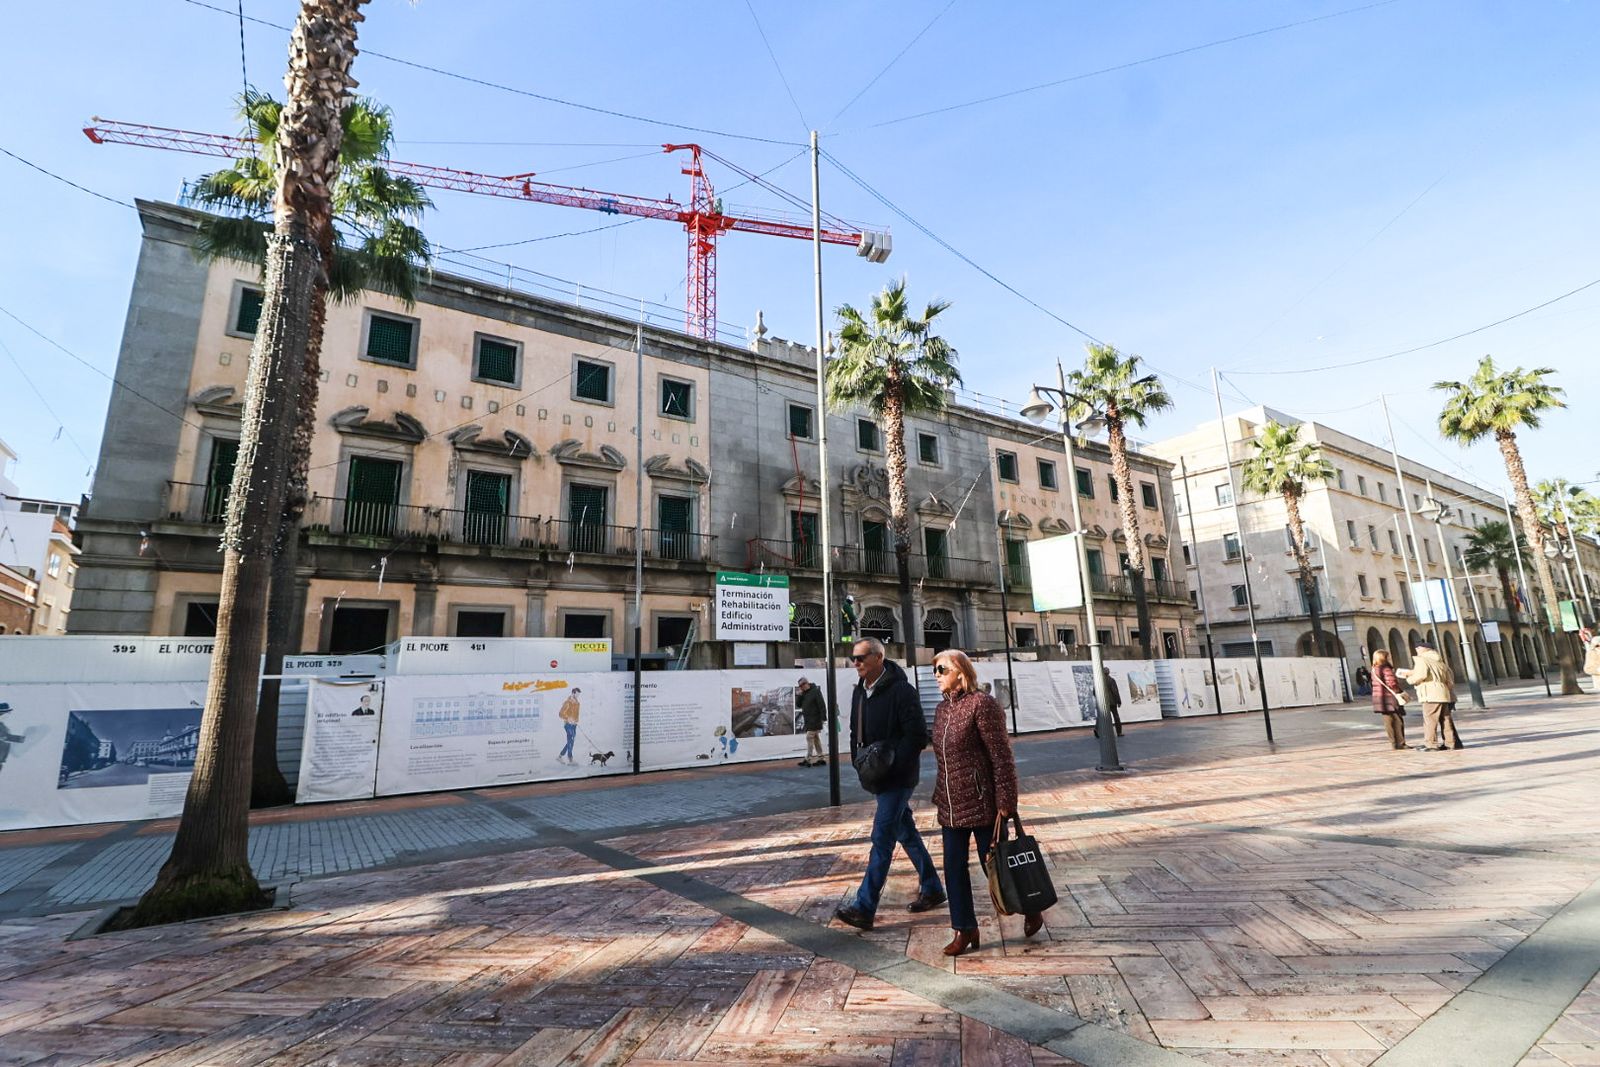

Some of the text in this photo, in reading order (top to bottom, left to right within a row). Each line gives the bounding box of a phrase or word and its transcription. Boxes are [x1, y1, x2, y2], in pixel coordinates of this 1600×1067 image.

[721, 589, 774, 600] Terminación
[721, 600, 781, 610] Rehabilitación
[721, 610, 753, 620] Edificio
[721, 621, 784, 632] Administrativo
[158, 644, 171, 653] EL
[177, 644, 215, 653] PICOTE
[406, 643, 416, 651] EL
[420, 643, 449, 651] PICOTE
[285, 661, 294, 669] EL
[297, 660, 323, 668] PICOTE
